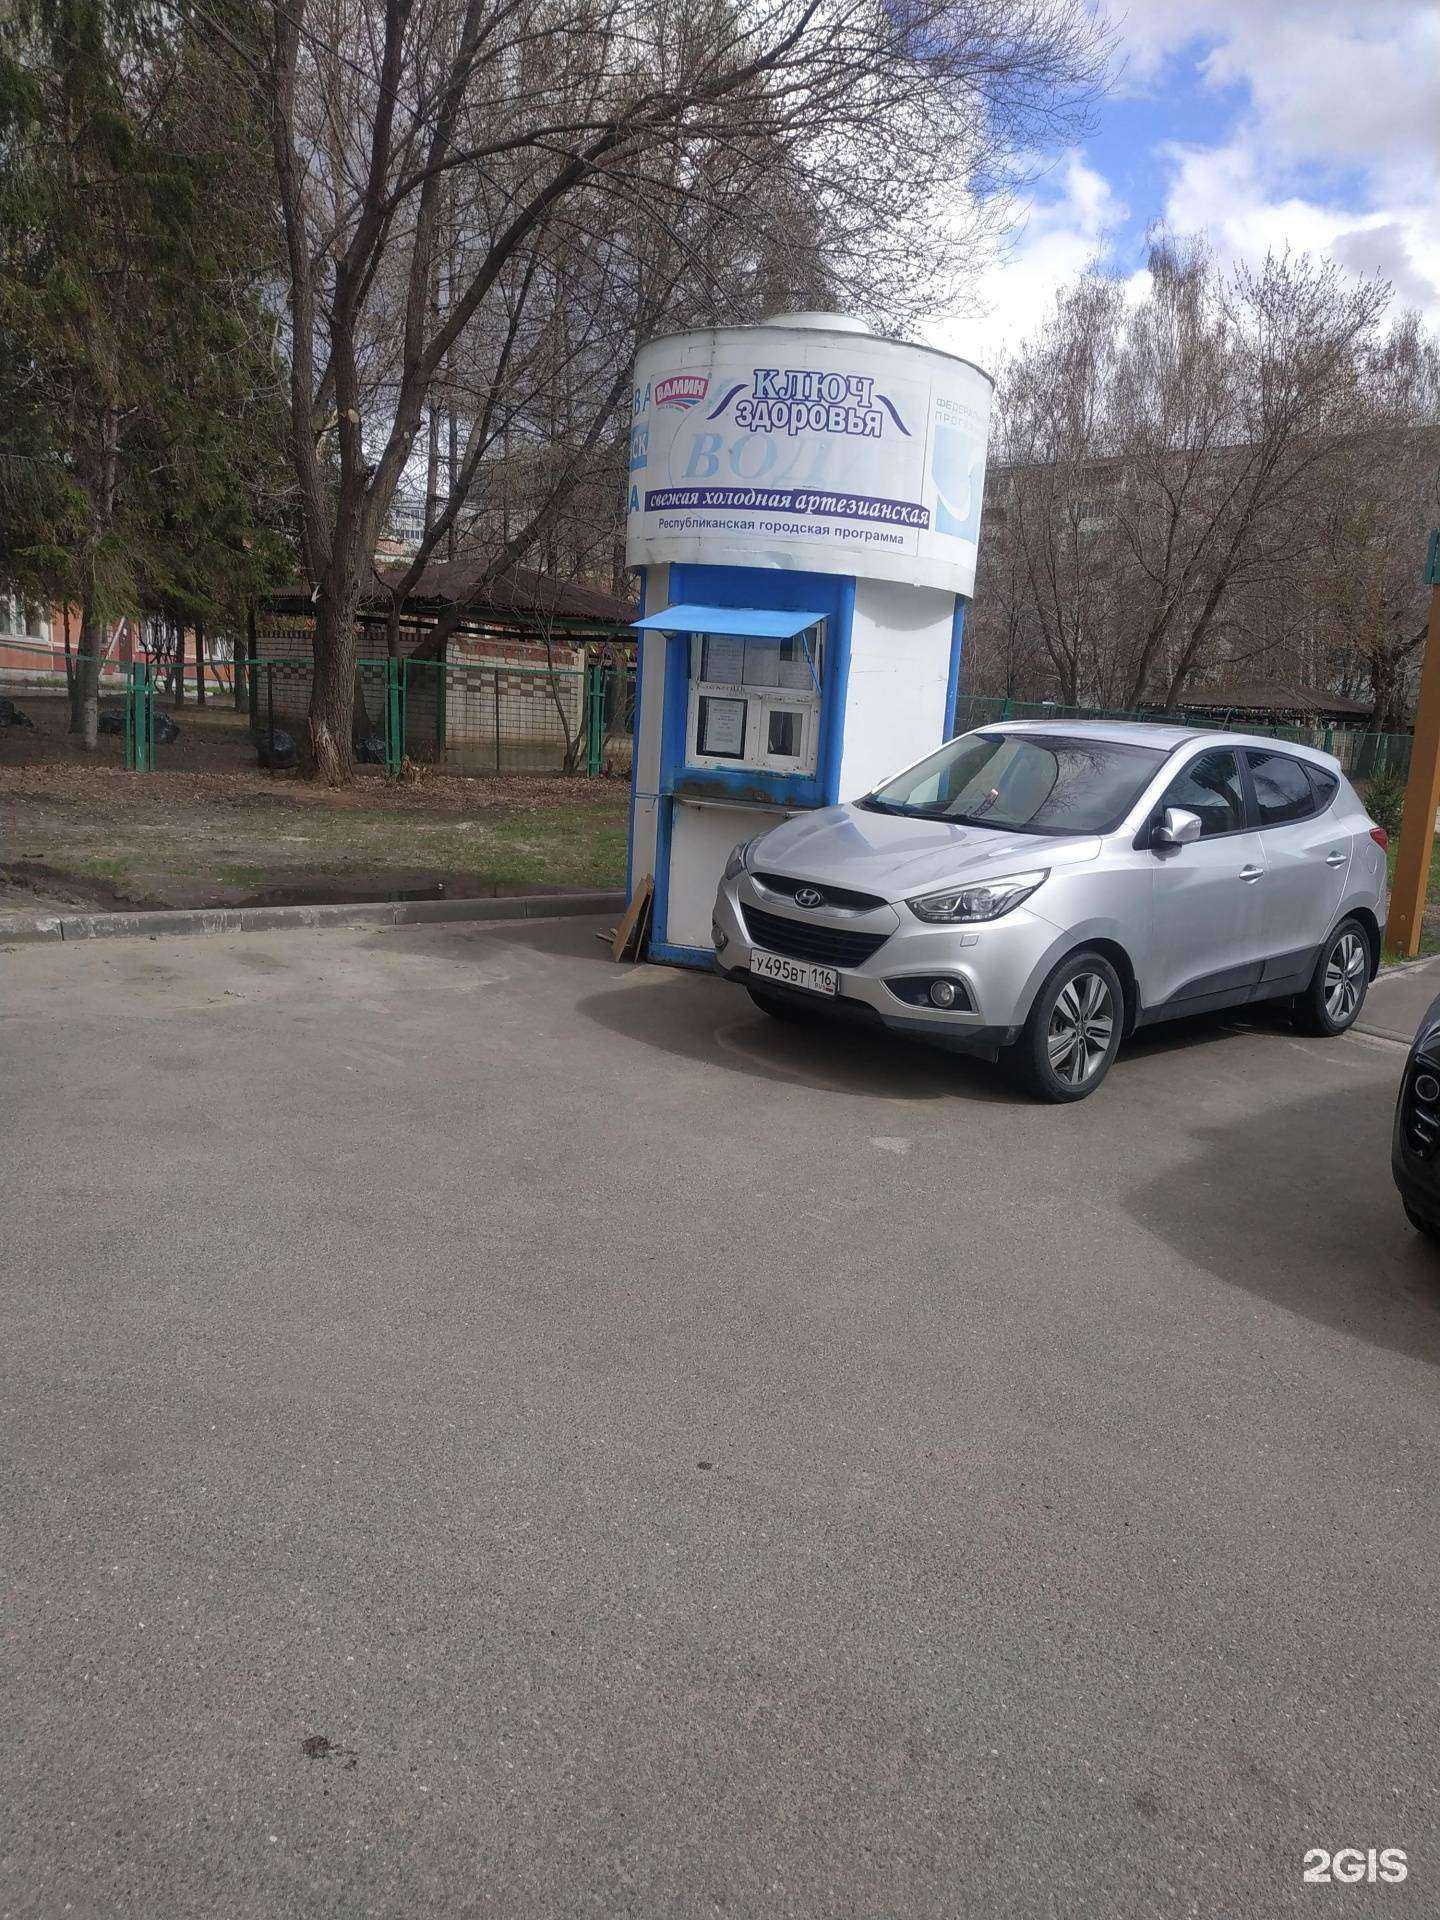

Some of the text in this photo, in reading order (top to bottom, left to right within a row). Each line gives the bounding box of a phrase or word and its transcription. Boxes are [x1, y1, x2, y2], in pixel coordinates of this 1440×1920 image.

[656, 378, 705, 402] ВАМИН
[752, 368, 875, 408] КЛЮЧ
[650, 487, 929, 525] свежая холодная артезианская
[658, 516, 904, 545] Республиканская городская программа
[811, 967, 832, 986] 116
